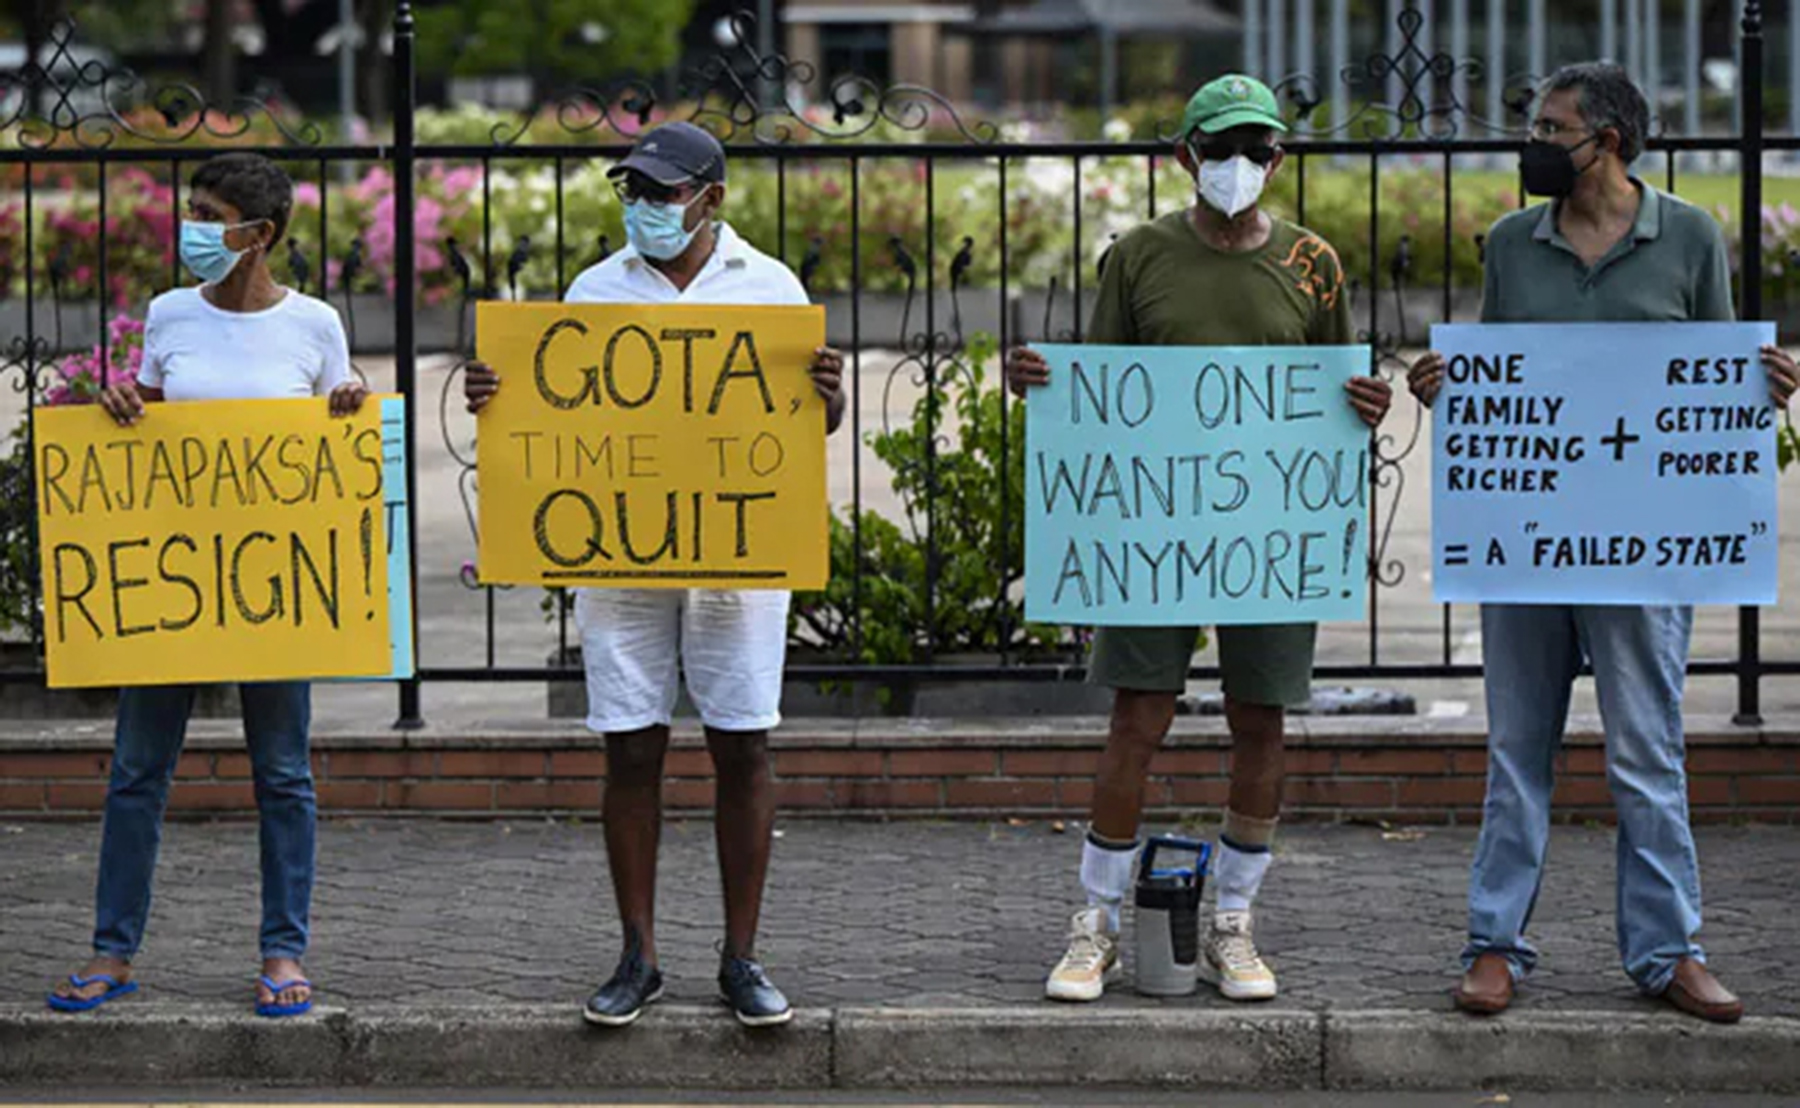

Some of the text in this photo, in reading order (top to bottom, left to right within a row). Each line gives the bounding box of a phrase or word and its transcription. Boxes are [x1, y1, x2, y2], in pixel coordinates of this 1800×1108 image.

[534, 318, 801, 415] GOTA,
[1447, 353, 1525, 385] ONE
[1665, 357, 1749, 386] REST
[1071, 361, 1324, 429] NO ONE
[1447, 395, 1564, 426] FAMILY
[1655, 405, 1773, 433] GETTING
[509, 431, 784, 480] TIME TO
[1445, 434, 1585, 463] GETTING
[1657, 450, 1760, 477] POORER
[42, 424, 383, 515] RAJAPAKSA'S
[1037, 450, 1367, 518] WANTS YOU
[1447, 465, 1559, 492] RICHER
[533, 489, 777, 568] QUIT
[1052, 518, 1358, 607] ANYMORE!
[1485, 538, 1507, 566] A
[53, 506, 375, 643] RESIGN!
